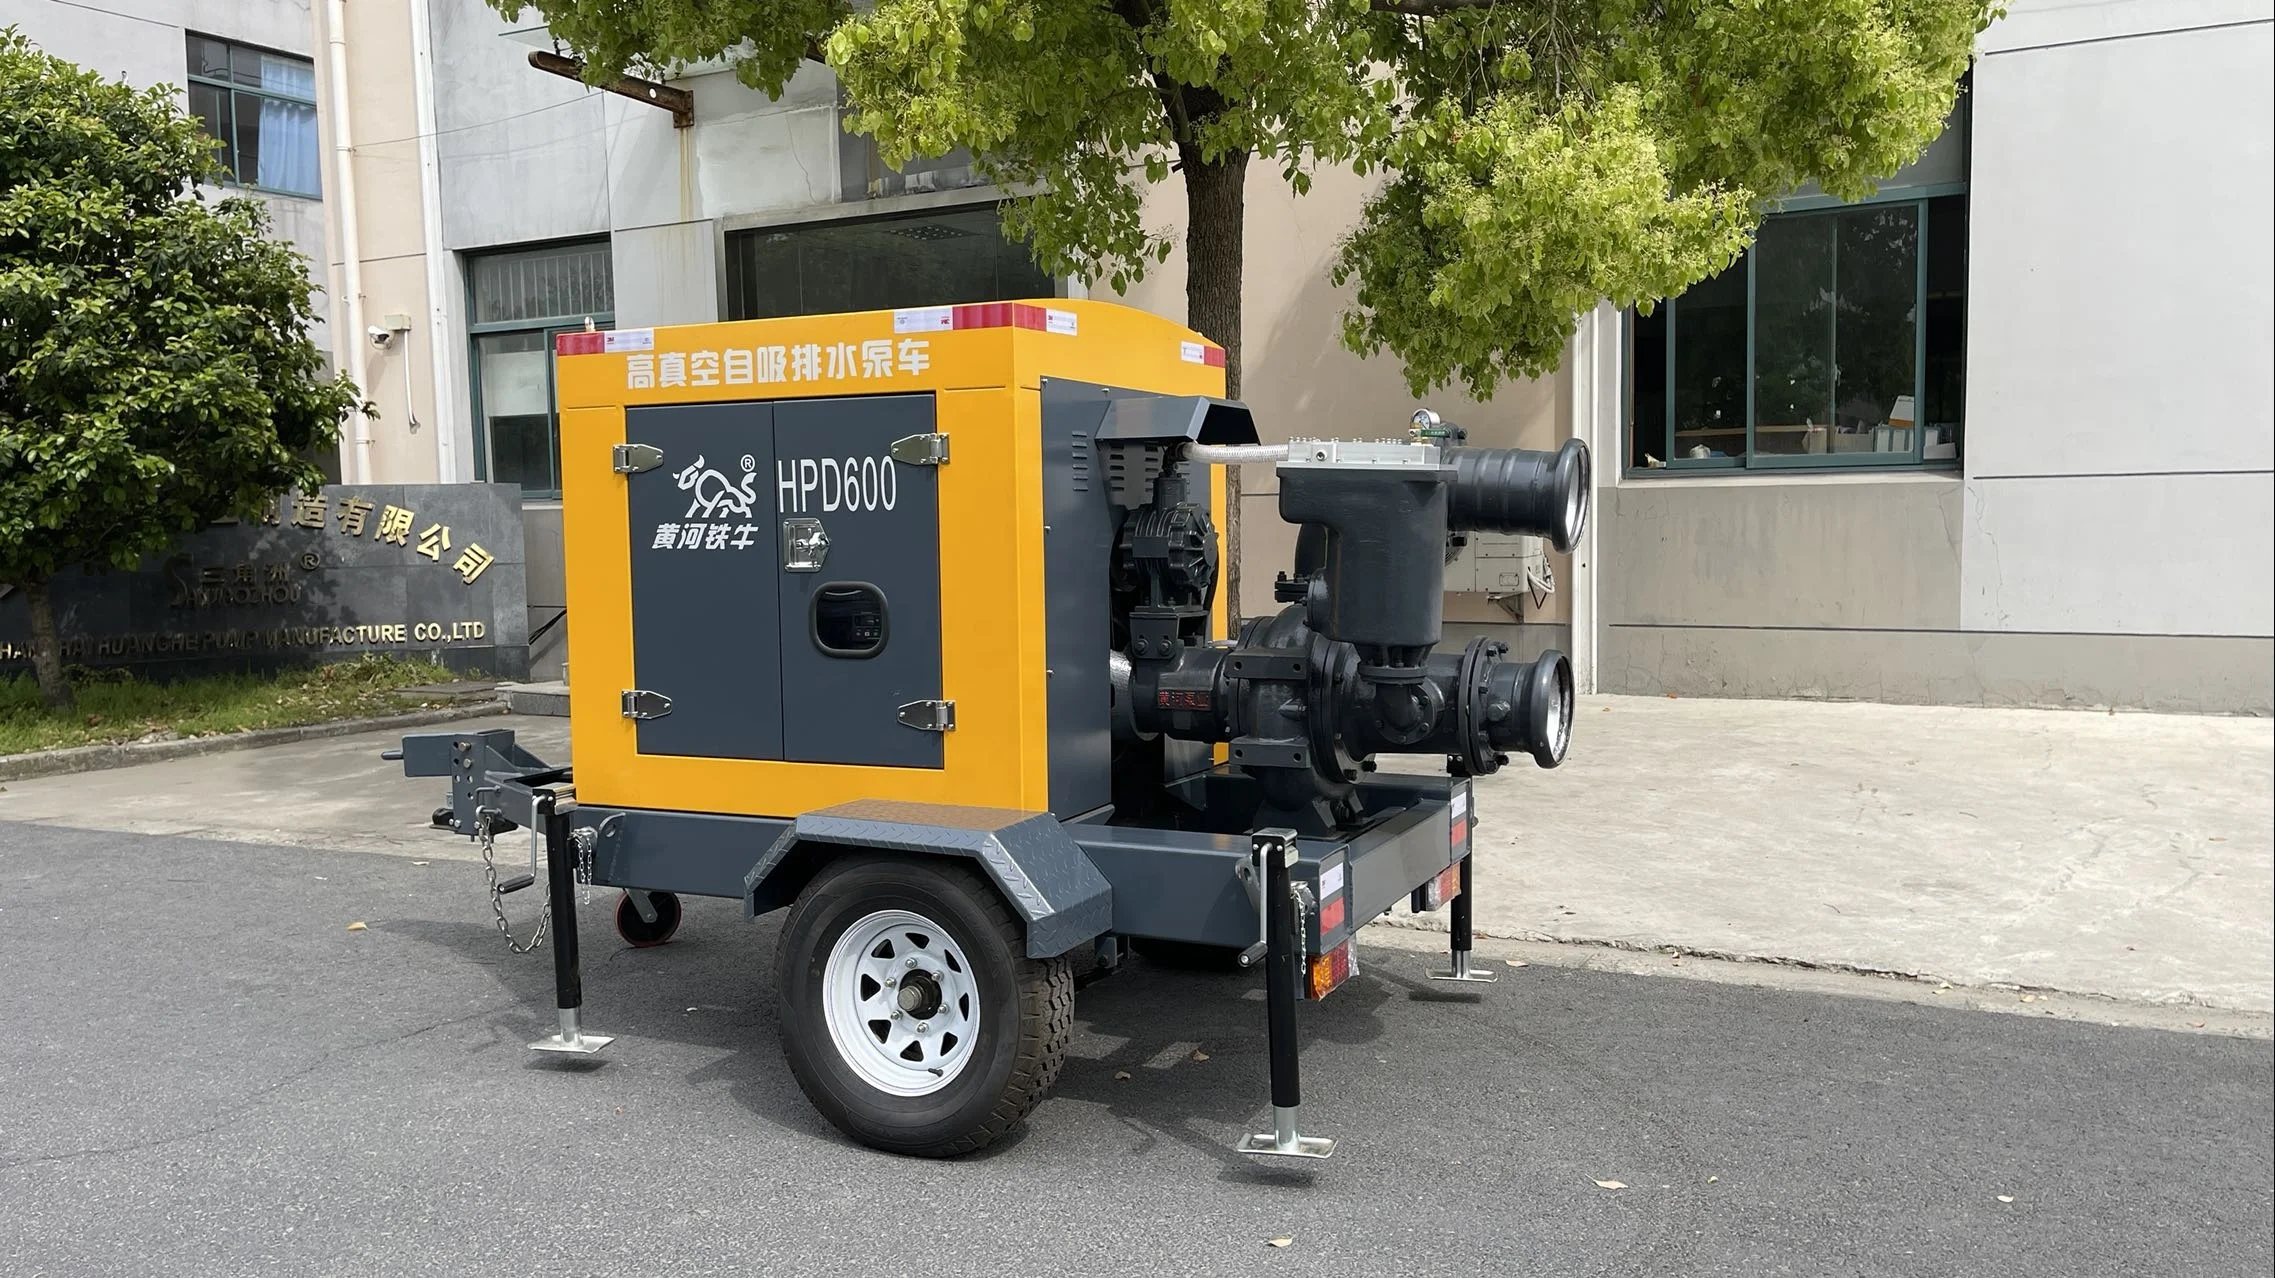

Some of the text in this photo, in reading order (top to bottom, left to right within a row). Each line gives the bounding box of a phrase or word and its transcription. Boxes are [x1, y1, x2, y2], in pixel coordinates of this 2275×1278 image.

[627, 338, 930, 389] 高真空自吸排水泵车
[778, 455, 897, 513] HPD600
[210, 494, 495, 584] 造有限公司
[651, 522, 759, 550] 黄河铁牛
[264, 624, 406, 648] MANUFACTURE
[414, 621, 486, 643] CO.,LTD
